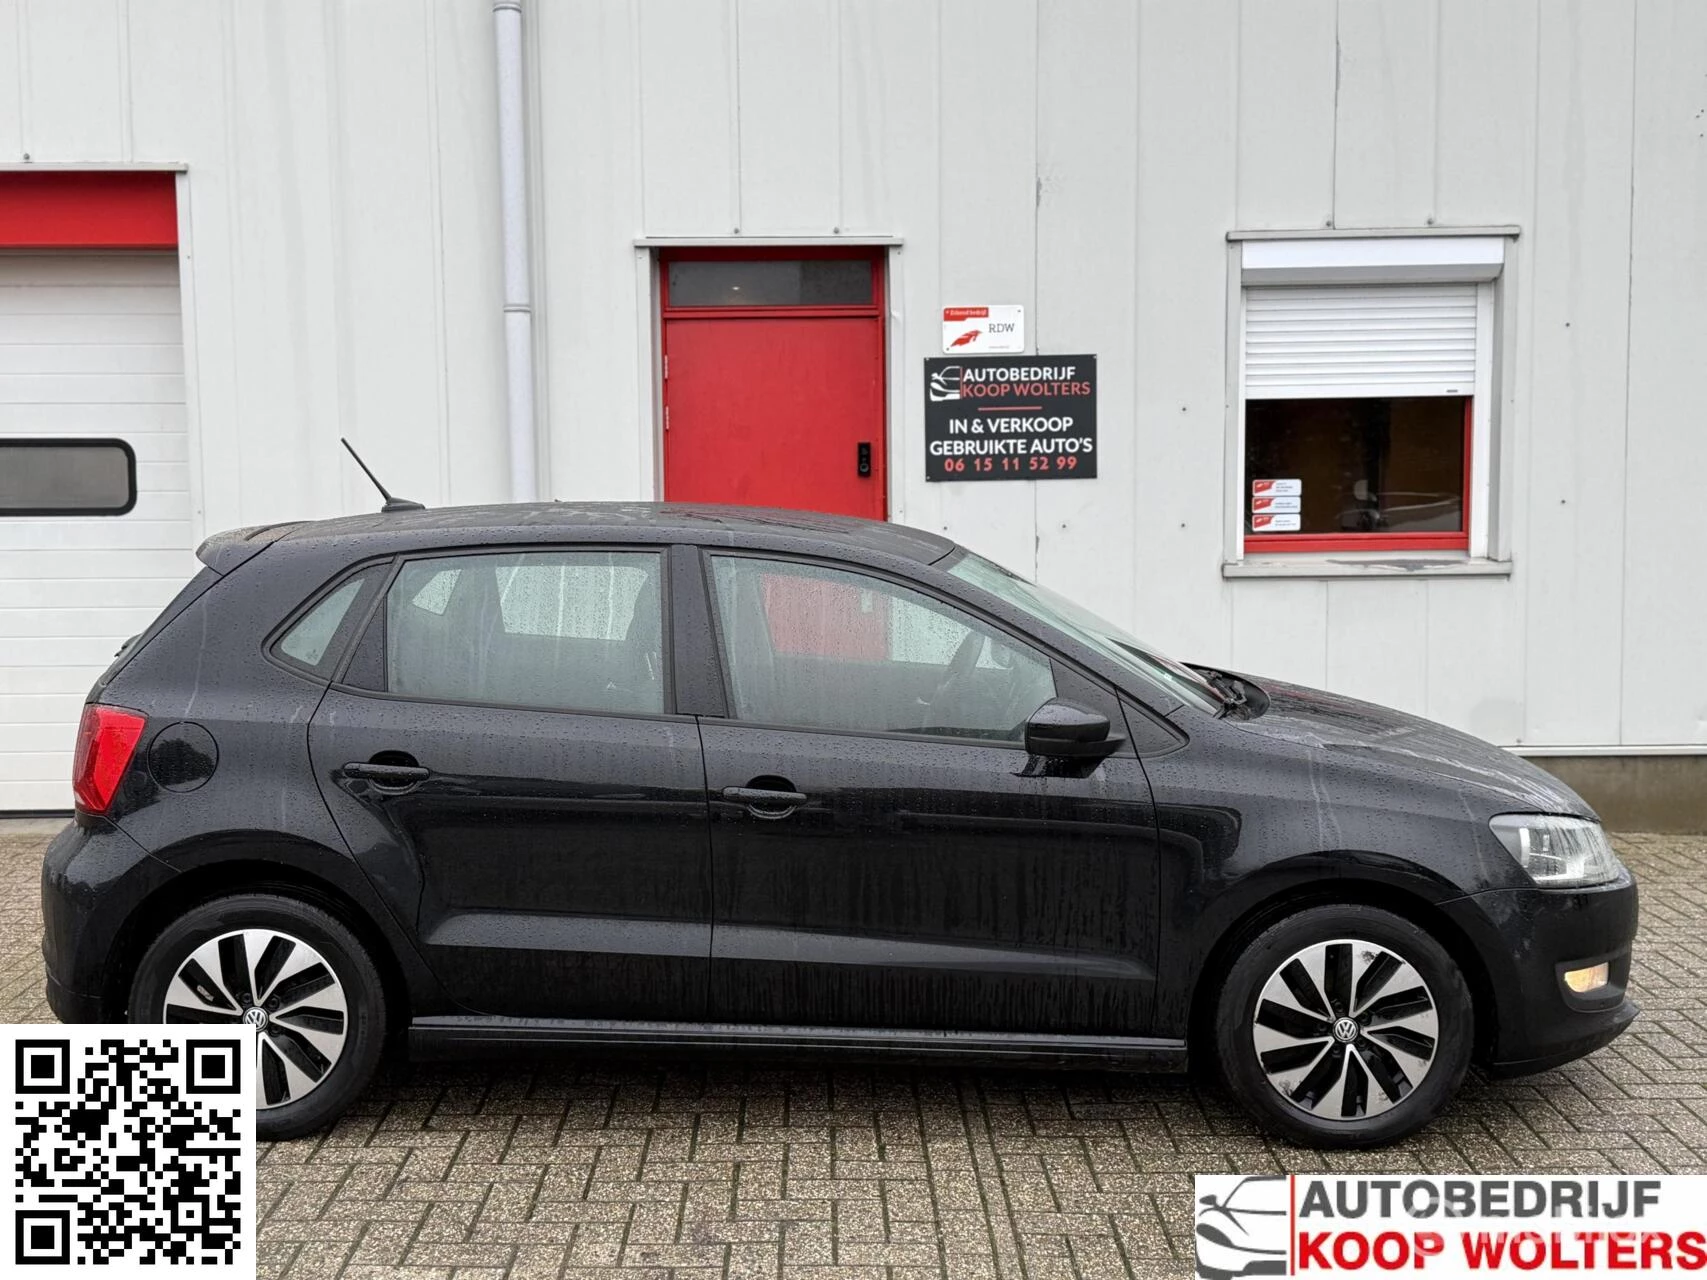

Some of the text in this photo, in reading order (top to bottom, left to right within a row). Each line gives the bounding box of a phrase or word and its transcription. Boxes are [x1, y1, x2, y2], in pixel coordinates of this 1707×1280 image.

[988, 323, 1015, 333] RDW
[963, 366, 1076, 382] AUTOBEDRIJF
[963, 382, 1091, 398] KOOP WOLTERS
[949, 416, 1073, 434] IN & VERKOOP
[930, 437, 1093, 455] GEBRUIKTE AUTO'S
[944, 456, 1077, 472] 06 15 11 52 99
